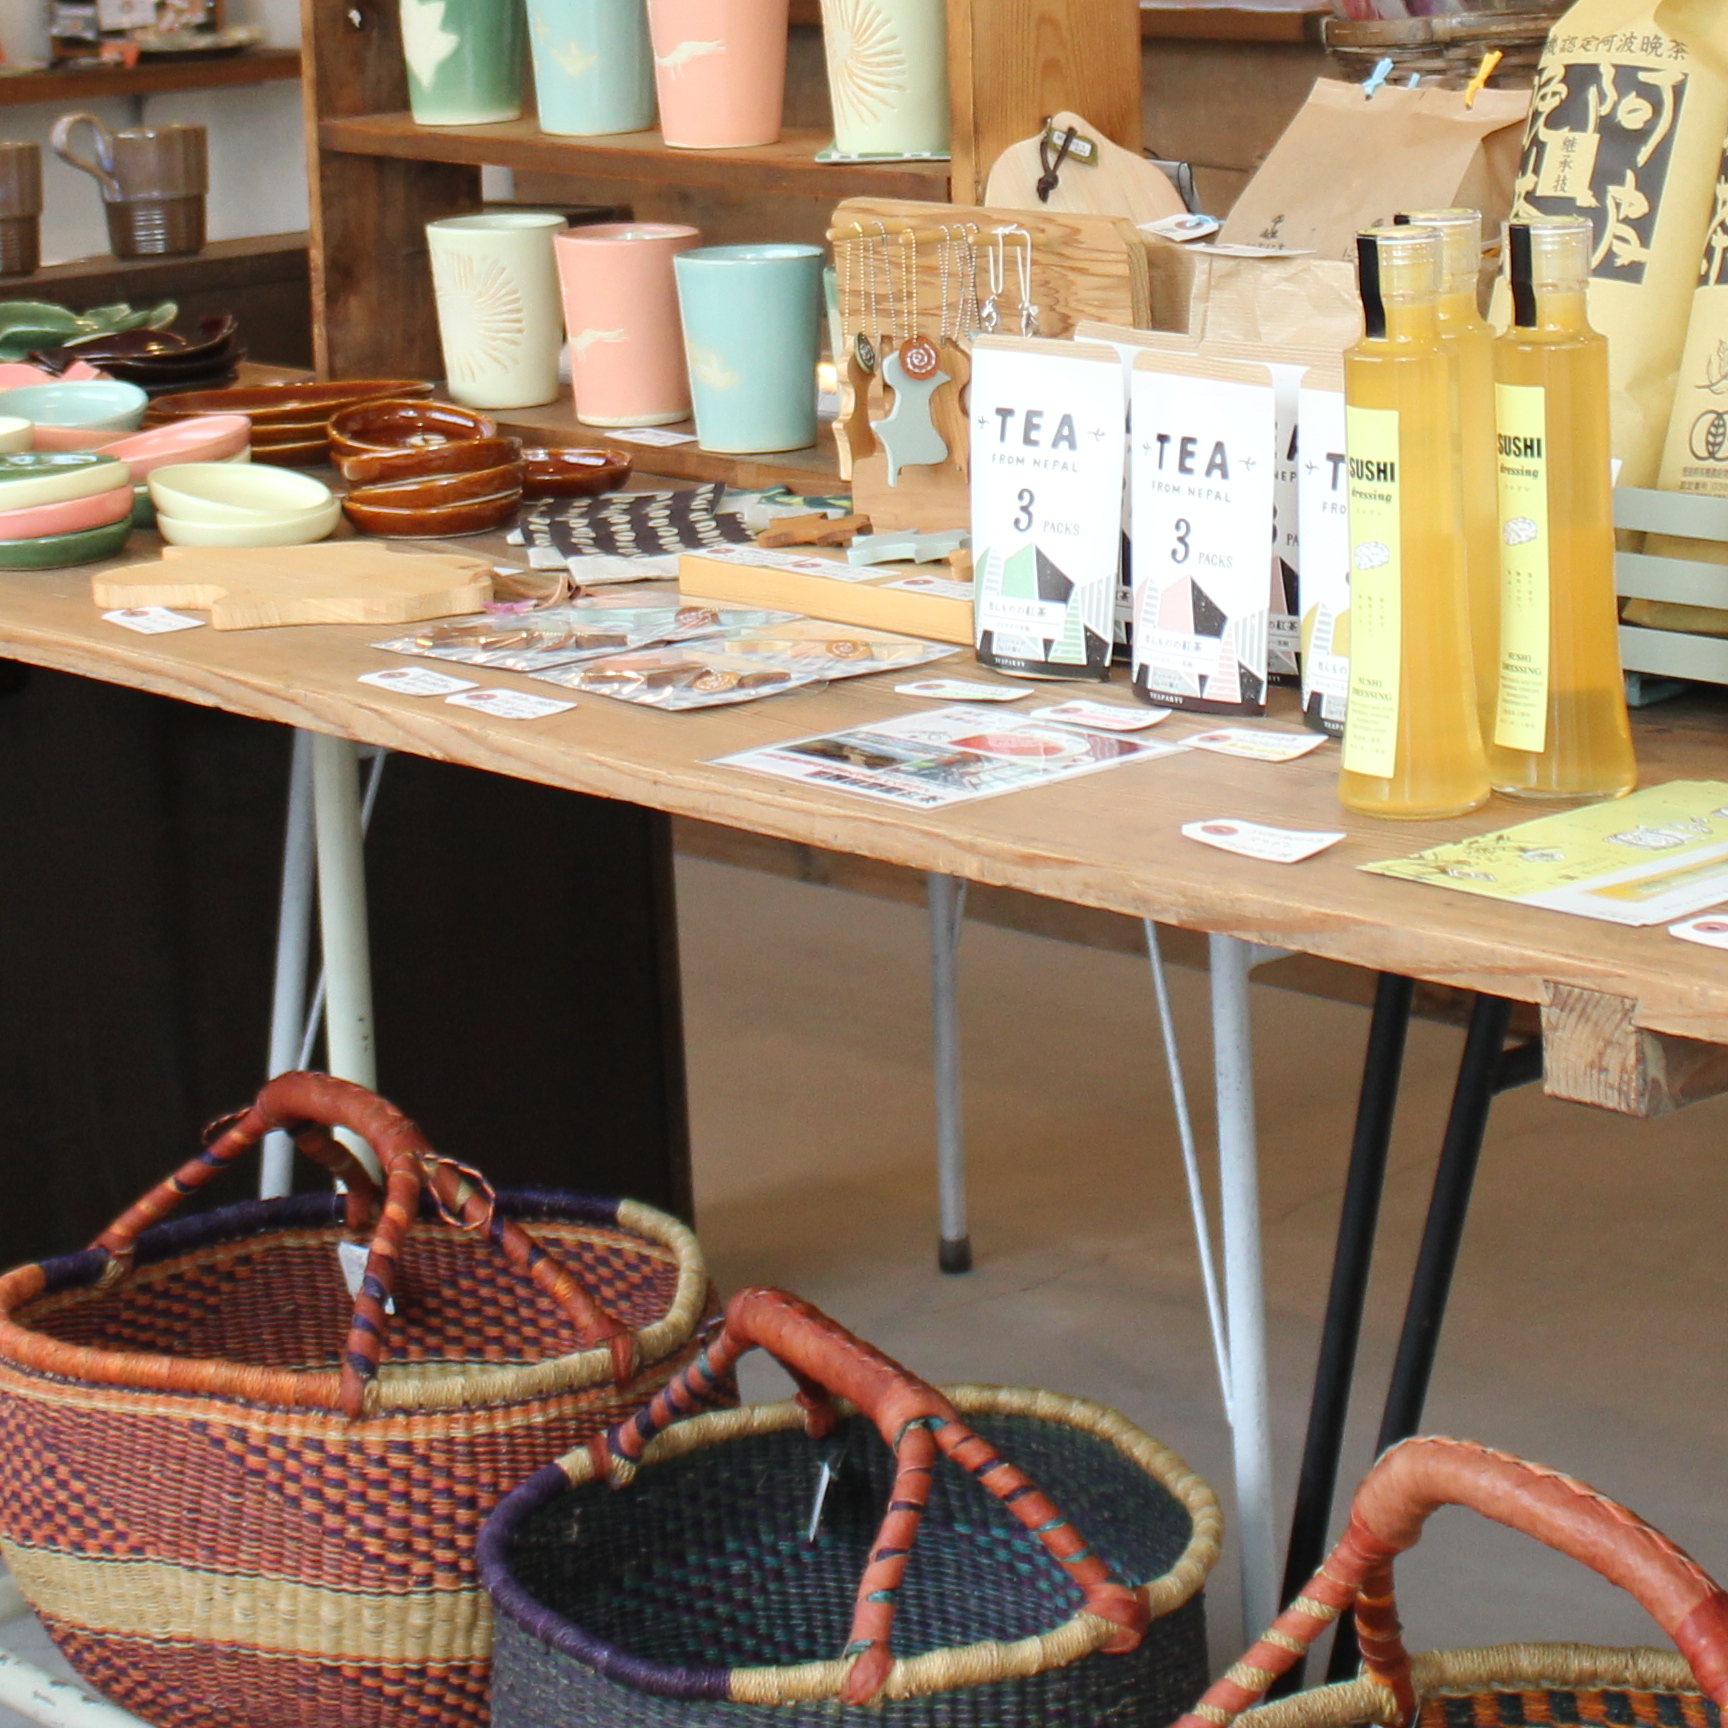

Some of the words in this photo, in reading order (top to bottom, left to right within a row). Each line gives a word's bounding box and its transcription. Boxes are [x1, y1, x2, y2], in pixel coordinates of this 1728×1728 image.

[995, 406, 1078, 451] TEA
[1497, 432, 1543, 460] SUSHI
[991, 453, 1025, 467] FROM
[1033, 457, 1079, 473] NEPAL
[1156, 432, 1230, 481] TEA
[1349, 455, 1397, 484] SUSHI
[1151, 479, 1181, 495] FROM
[1188, 486, 1232, 503] NEPAL
[1013, 488, 1036, 533] 3
[1043, 520, 1080, 537] PACKS
[1170, 518, 1192, 565] 3
[1198, 552, 1234, 570] PACKS
